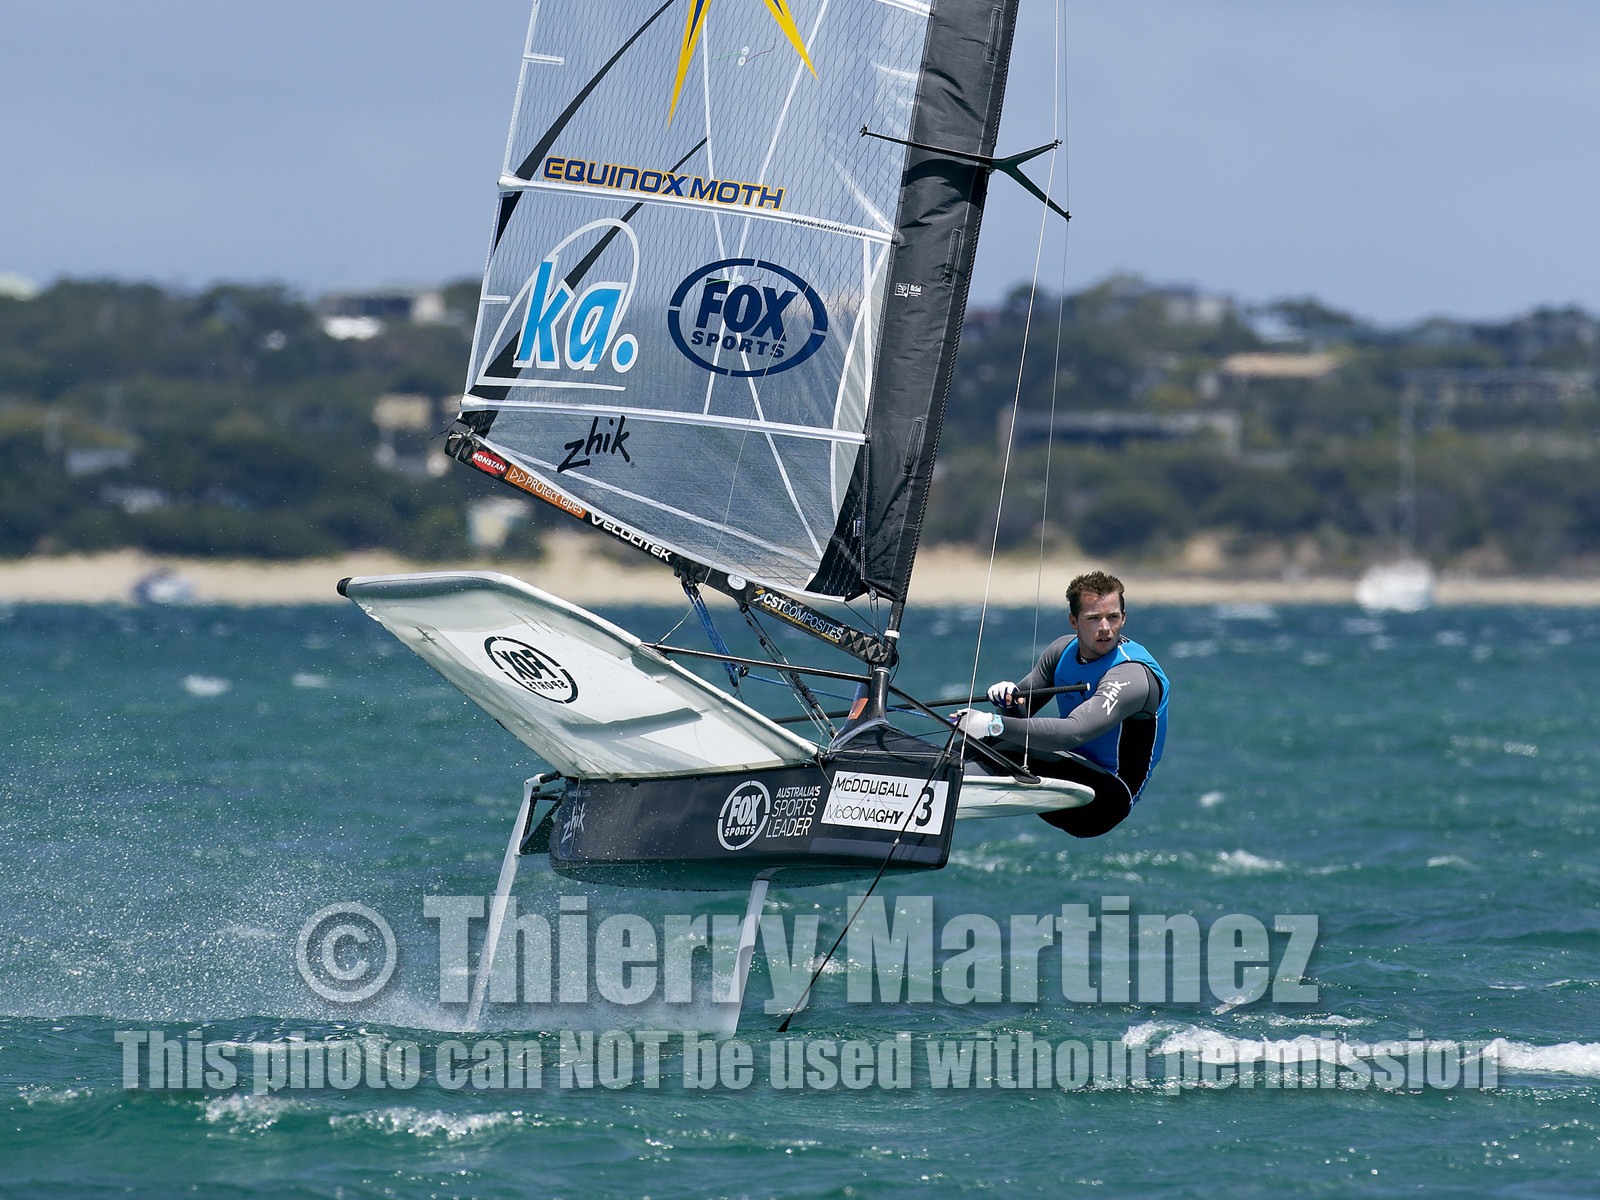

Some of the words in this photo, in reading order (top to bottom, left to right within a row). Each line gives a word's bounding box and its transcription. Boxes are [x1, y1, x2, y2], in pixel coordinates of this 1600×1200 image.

[543, 156, 690, 199] EQUINOX
[689, 176, 785, 211] MOTH
[696, 277, 798, 342] FOX
[691, 330, 785, 358] SPORTS
[557, 415, 631, 473] zhik
[472, 453, 506, 472] RONSTAN
[525, 476, 558, 501] PROtect
[559, 493, 584, 515] tapes
[590, 513, 673, 562] VELOCITEK
[1101, 680, 1129, 716] zhik
[771, 798, 818, 817] SPORTS
[776, 786, 821, 798] AUSTRALIA'S
[915, 786, 935, 827] 3
[727, 794, 763, 827] FOX
[766, 817, 812, 838] LEADER
[724, 826, 756, 837] SPORTS
